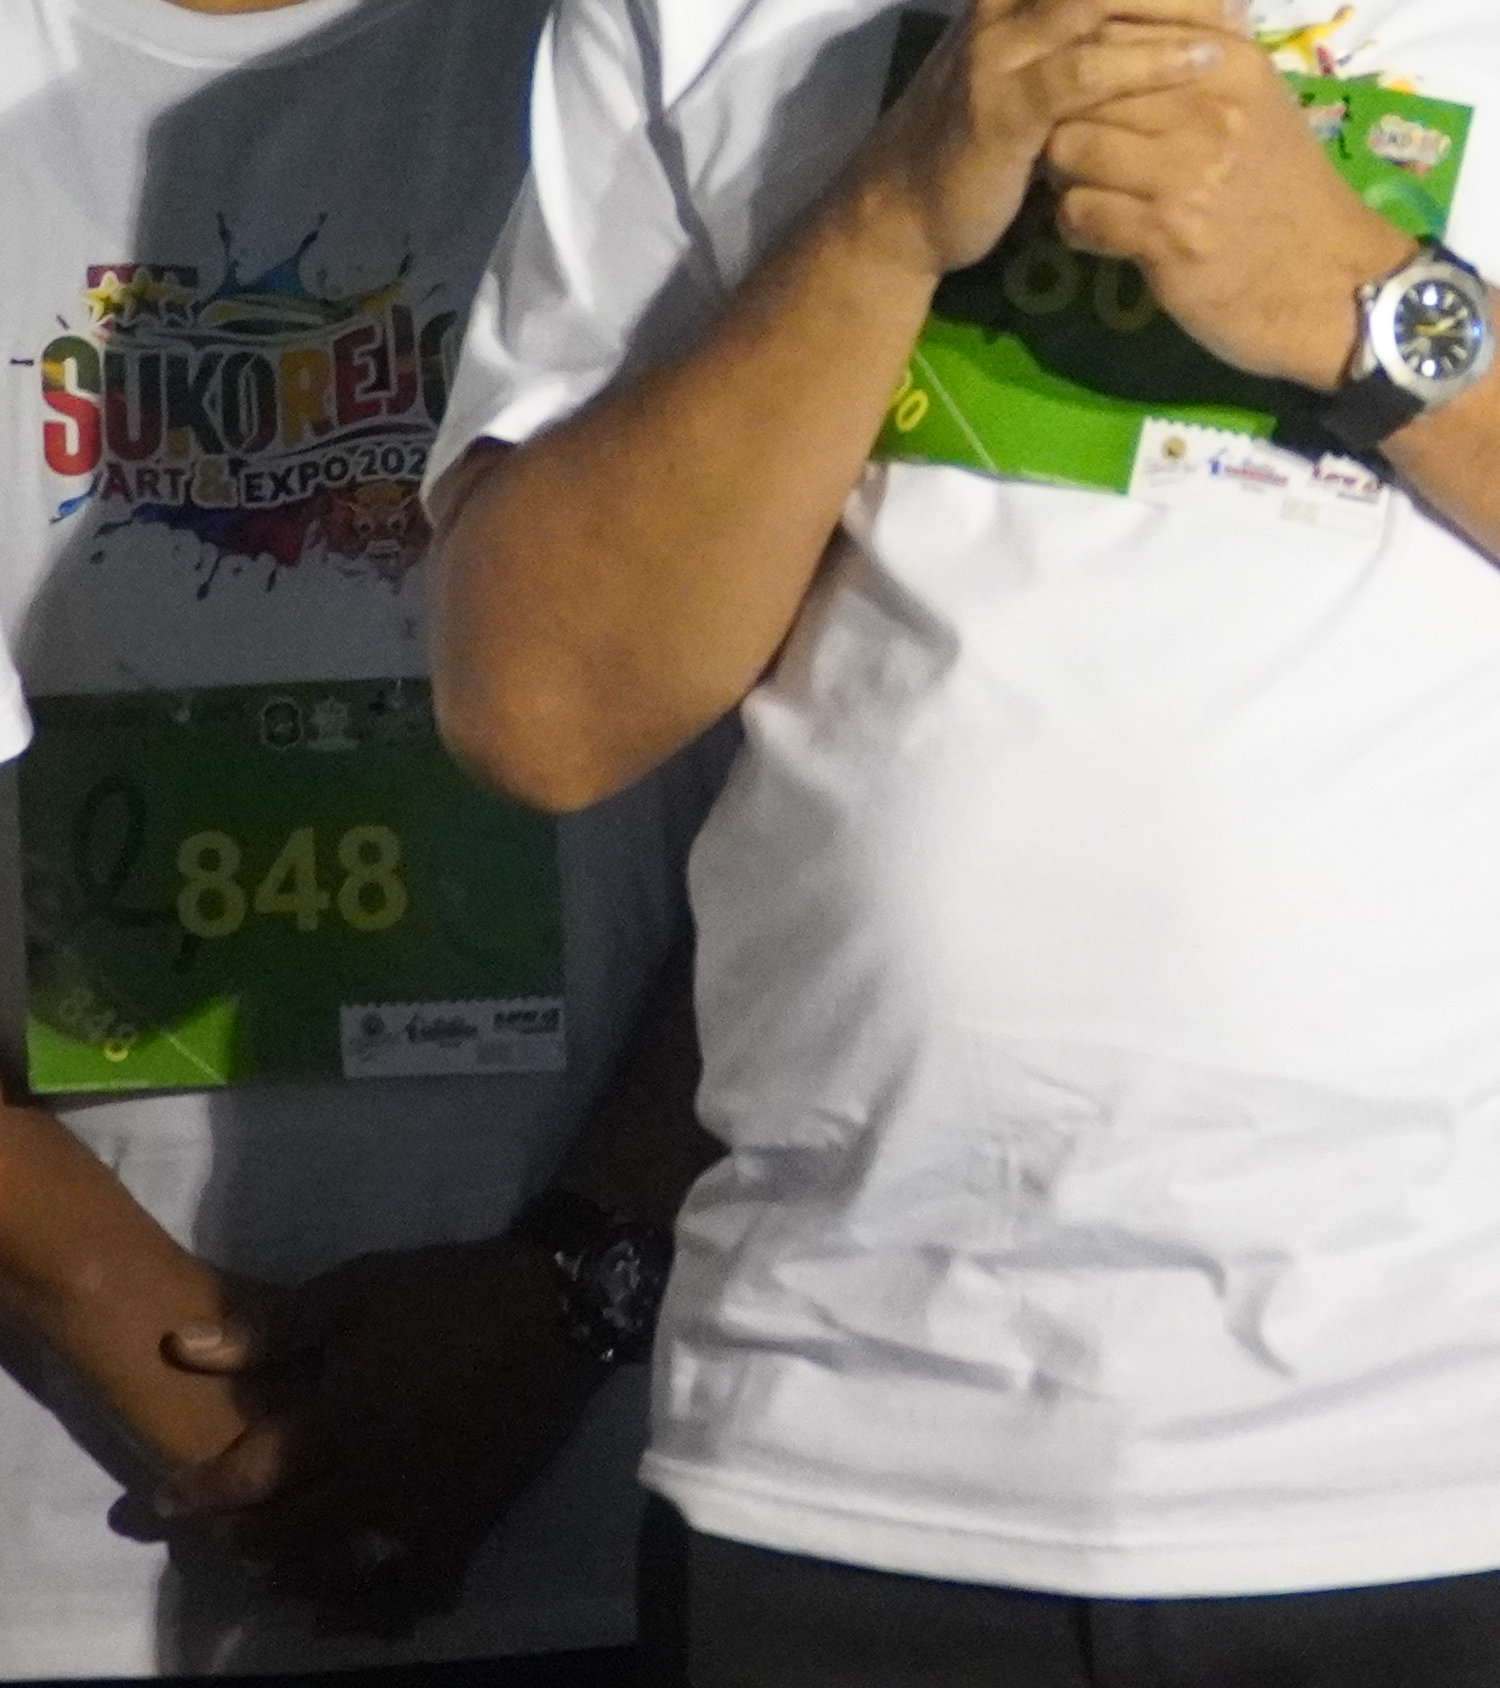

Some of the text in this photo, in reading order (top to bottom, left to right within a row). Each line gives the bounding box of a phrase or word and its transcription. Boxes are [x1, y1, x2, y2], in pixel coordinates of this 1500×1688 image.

[102, 464, 184, 502] ART
[245, 460, 348, 502] EXPO
[176, 825, 408, 939] 848
